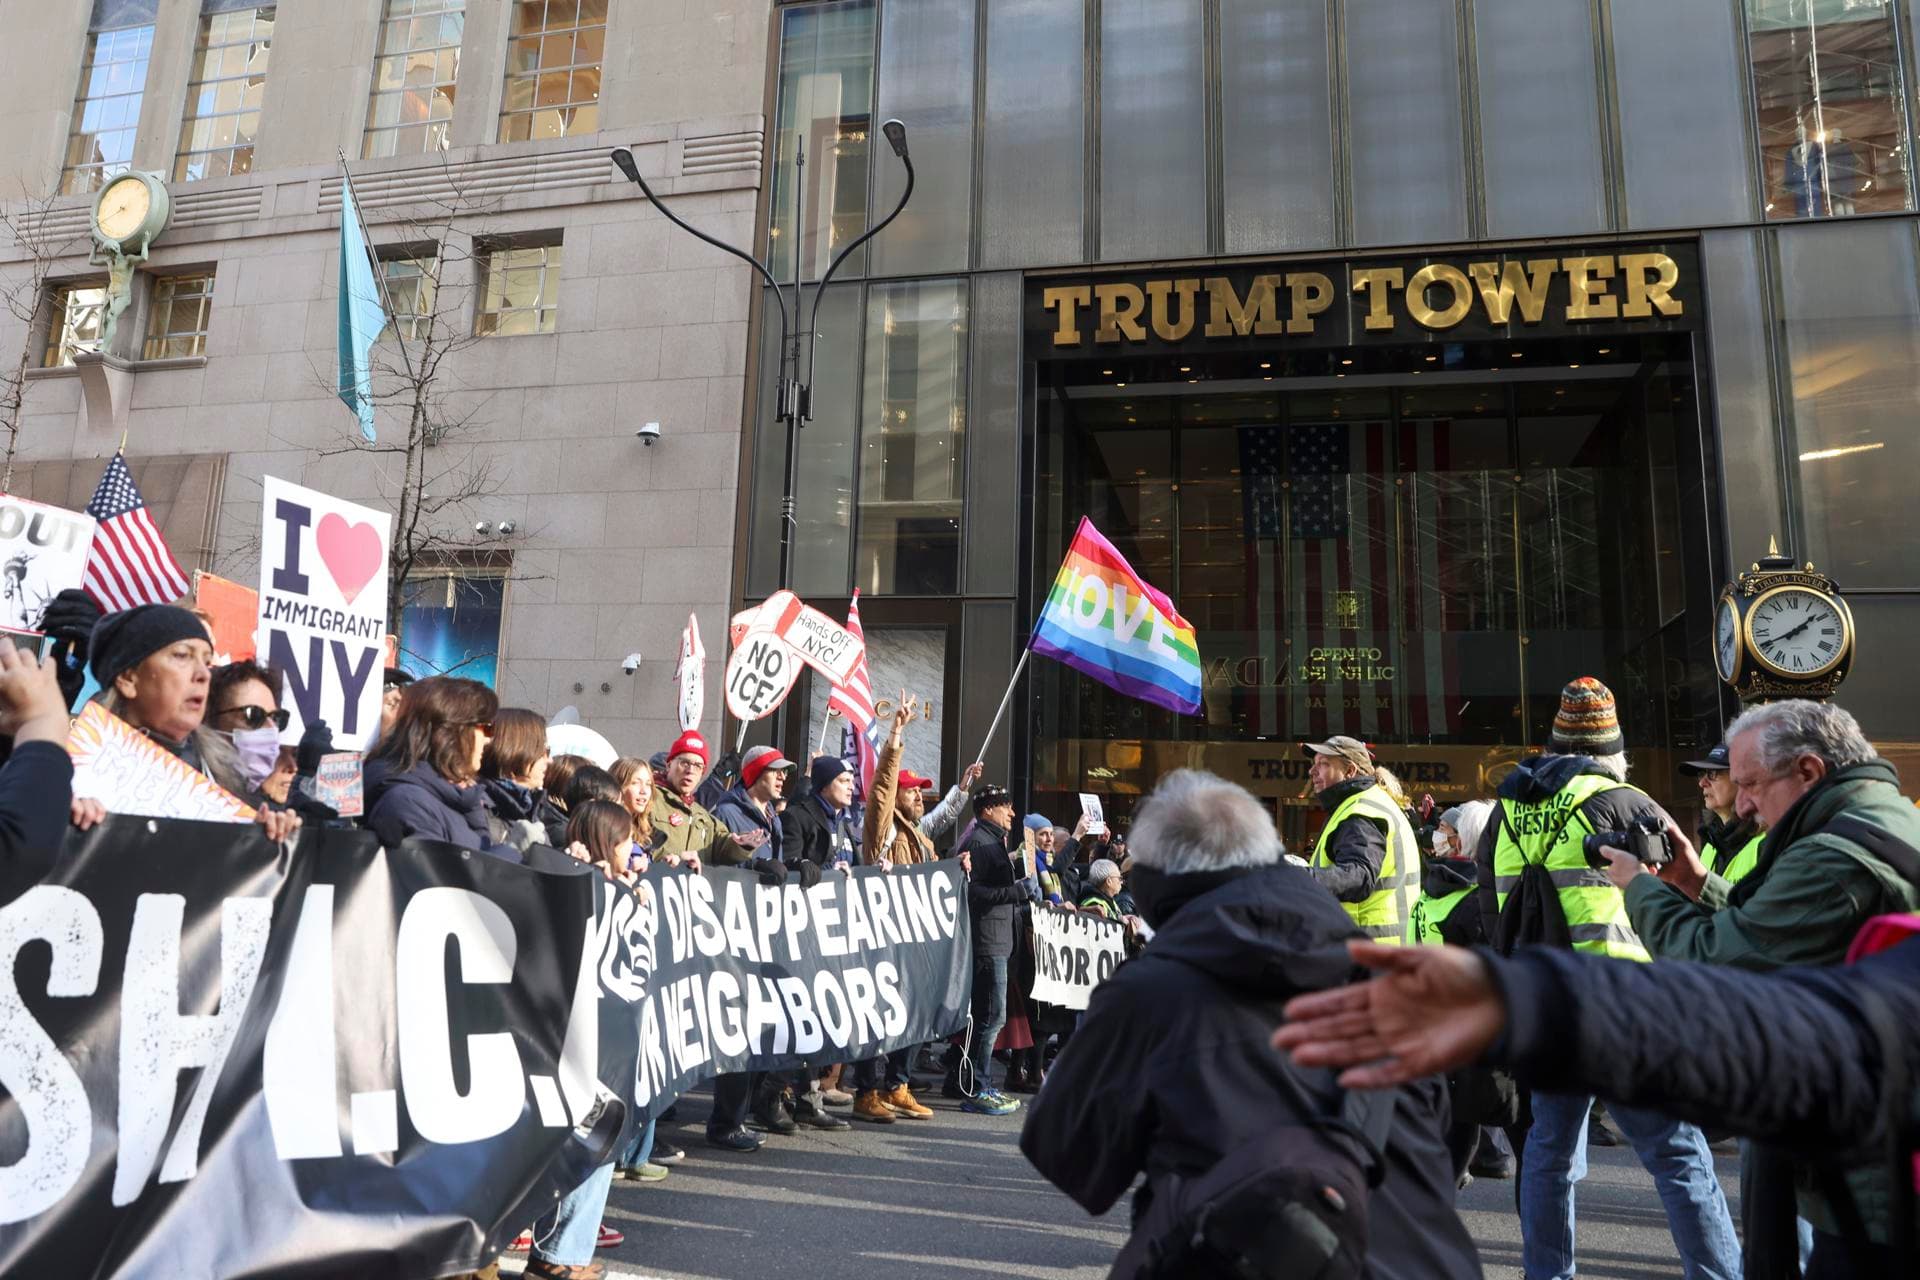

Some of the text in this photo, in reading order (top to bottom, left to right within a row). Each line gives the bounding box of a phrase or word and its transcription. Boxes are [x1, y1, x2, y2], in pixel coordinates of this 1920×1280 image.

[1043, 253, 1683, 346] TRUMP TOWER
[0, 505, 88, 553] OUT
[272, 497, 311, 596] I
[1757, 574, 1825, 589] TRUMP TOWER
[262, 596, 383, 640] IMMIGRANT
[796, 613, 829, 639] Hands
[1058, 566, 1179, 662] LOVE
[747, 639, 783, 678] NO
[802, 635, 842, 665] NYC!
[1310, 647, 1382, 662] OPEN TO
[268, 628, 379, 735] NY
[730, 666, 784, 714] ICE!
[1513, 808, 1570, 837] RESIST
[661, 869, 957, 964] DISAPPEARING
[660, 961, 908, 1081] NEIGHBORS
